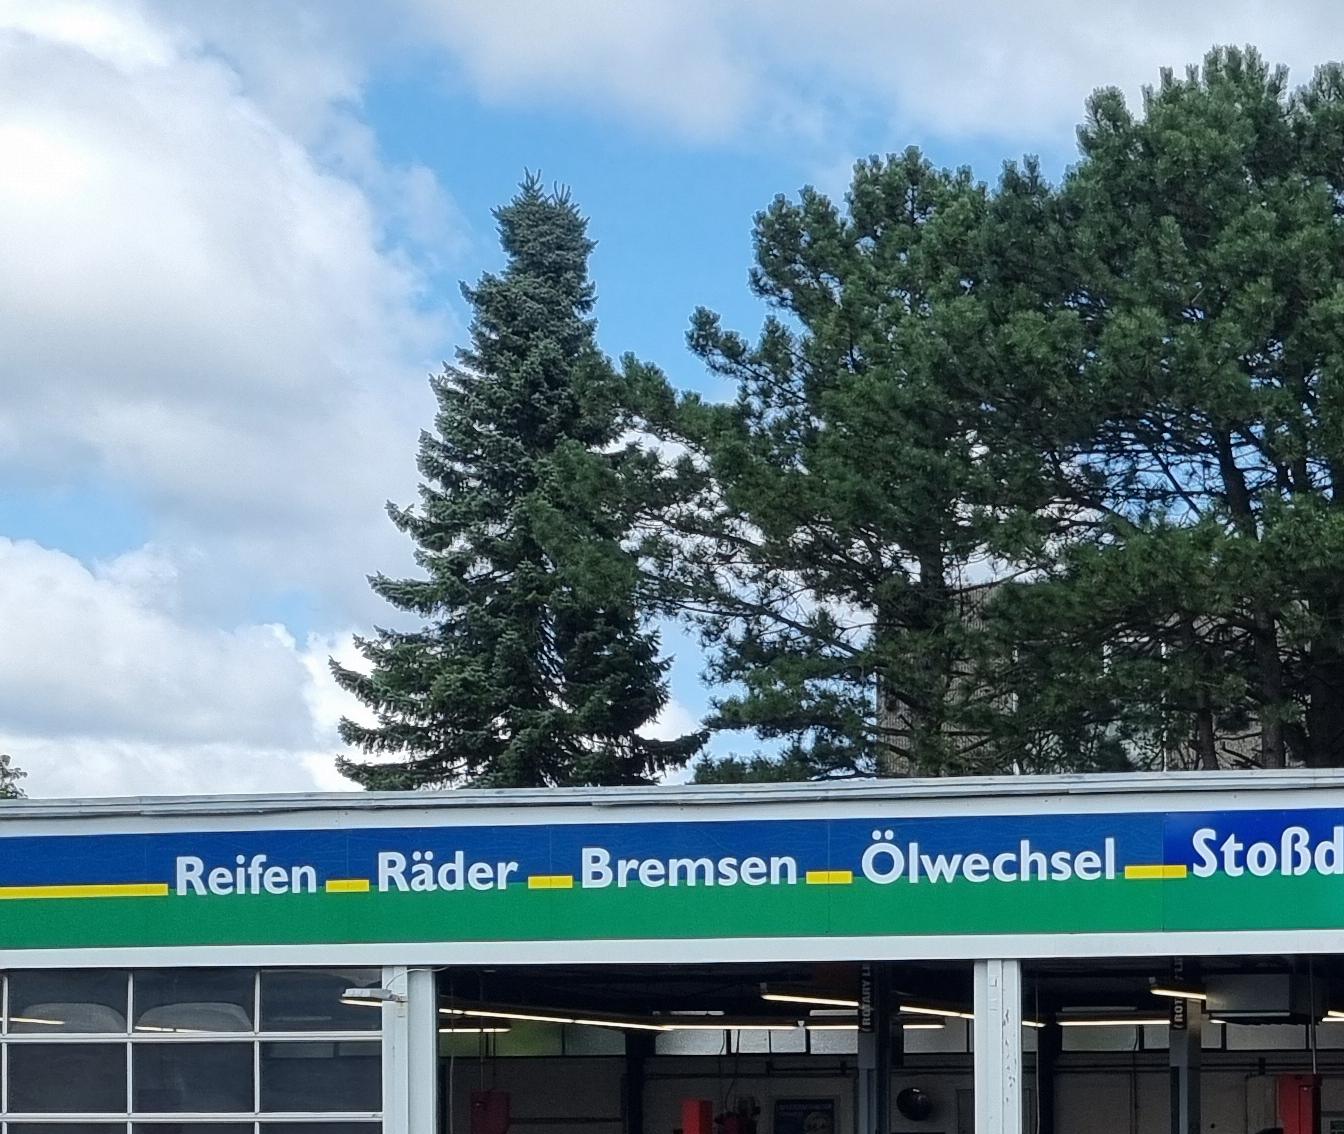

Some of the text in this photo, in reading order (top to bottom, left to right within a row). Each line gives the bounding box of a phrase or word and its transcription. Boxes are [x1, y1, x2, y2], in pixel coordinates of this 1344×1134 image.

[176, 854, 317, 896] Reifen
[378, 850, 519, 892] Räder
[581, 847, 797, 889] Bremsen
[861, 829, 1116, 885] Ölwechsel
